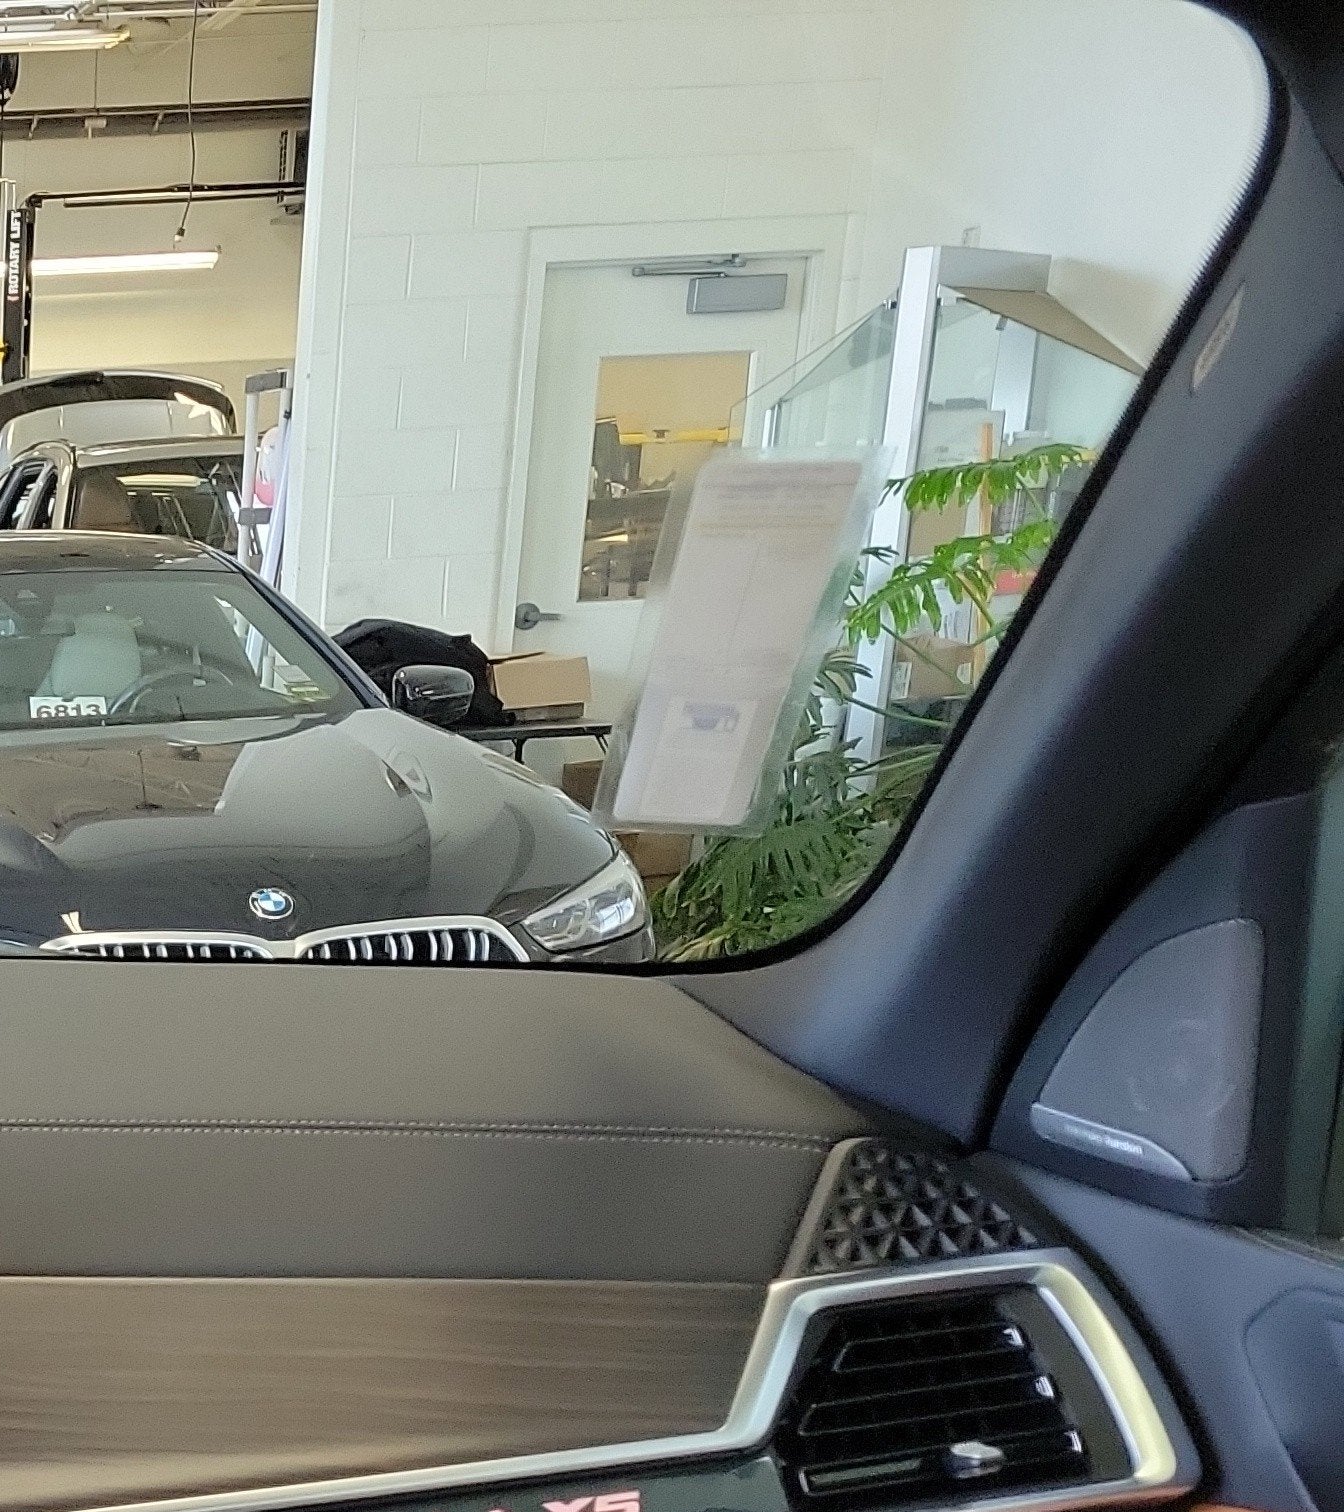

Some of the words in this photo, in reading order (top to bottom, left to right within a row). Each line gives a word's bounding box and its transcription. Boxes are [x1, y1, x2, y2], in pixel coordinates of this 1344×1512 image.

[10, 211, 22, 239] LIFT
[8, 241, 21, 295] ROTARY
[36, 703, 102, 718] 6813
